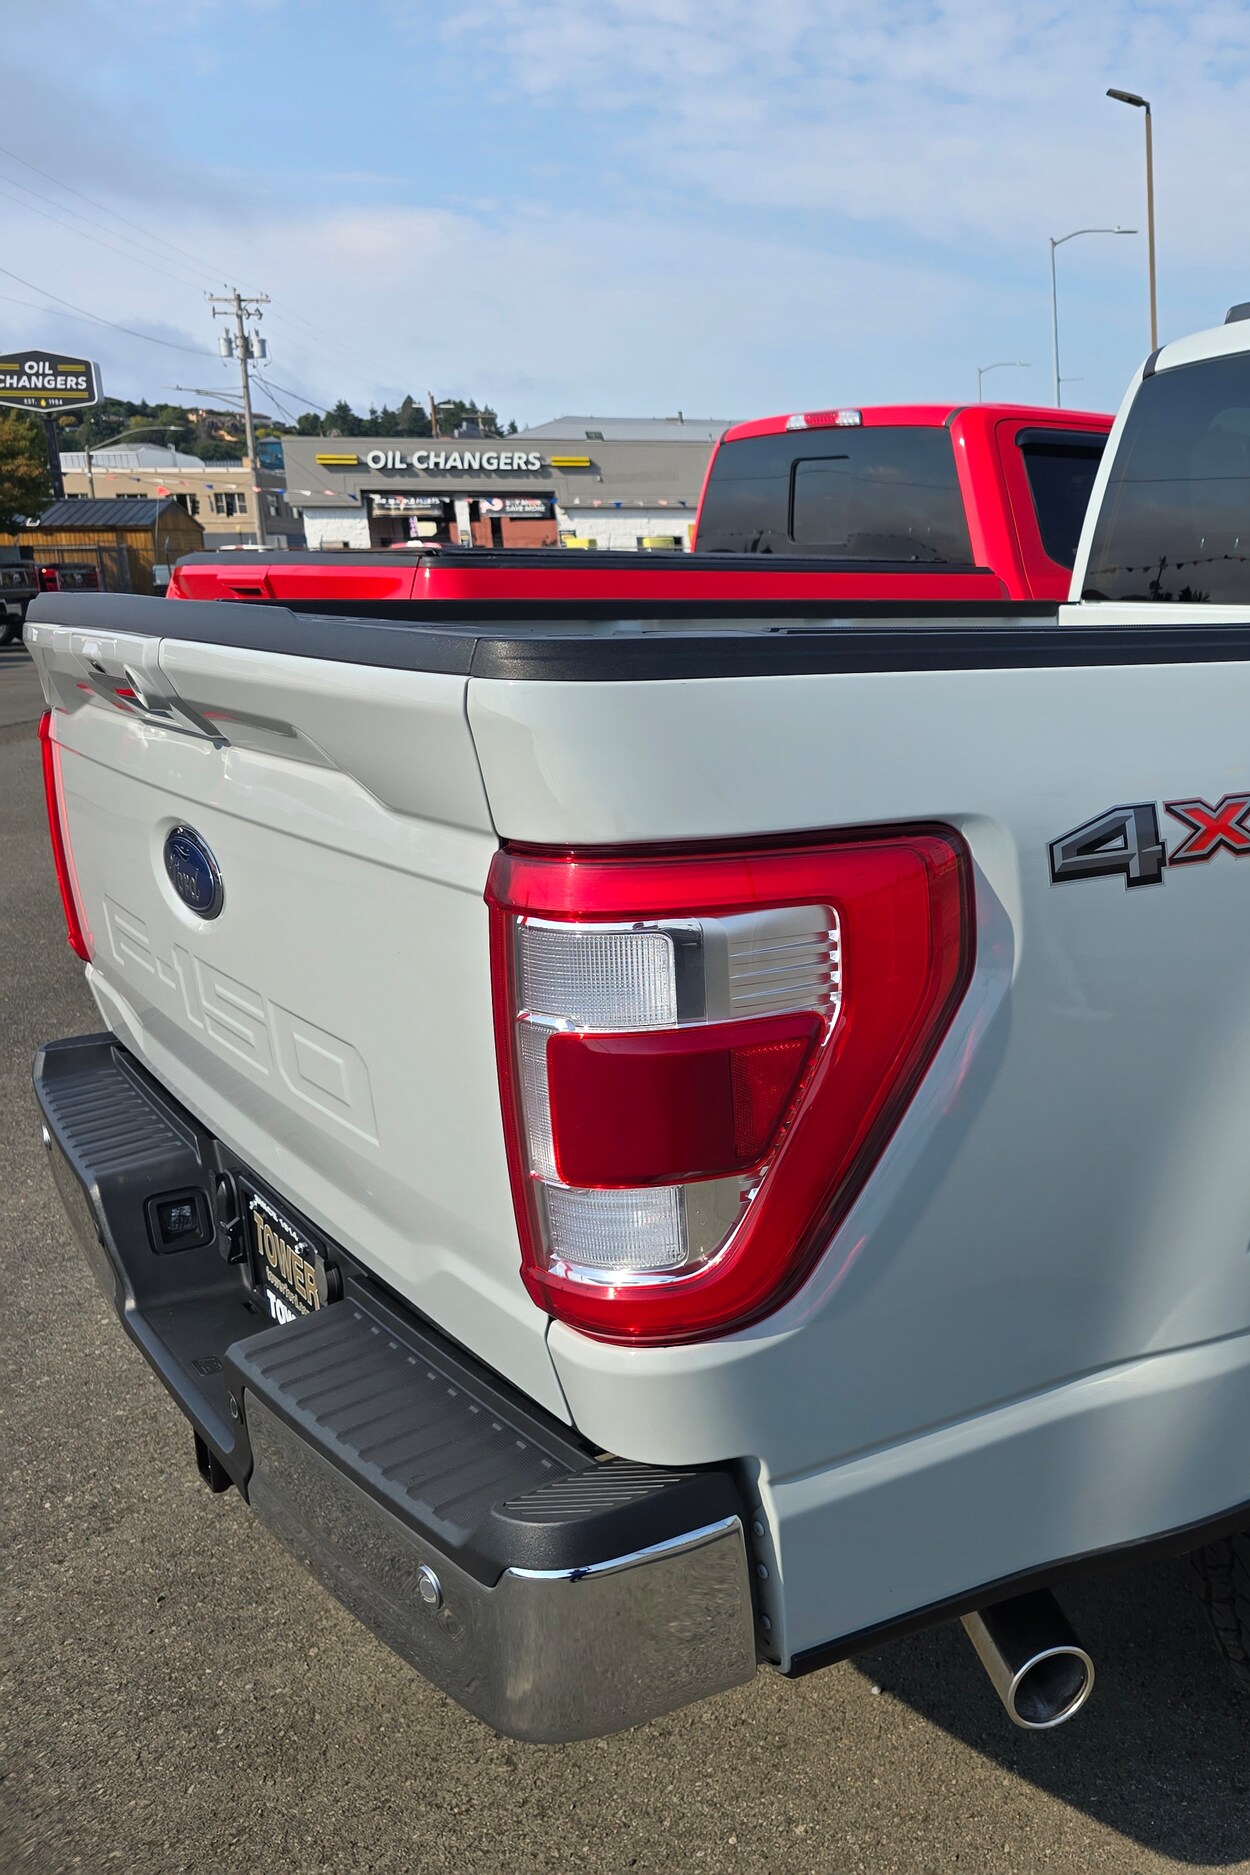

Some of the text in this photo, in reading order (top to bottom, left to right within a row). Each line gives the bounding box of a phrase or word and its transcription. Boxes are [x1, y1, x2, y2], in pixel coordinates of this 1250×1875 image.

[24, 361, 53, 374] OIL
[367, 450, 541, 471] OIL CHANGERS
[167, 845, 201, 903] Ford
[253, 1209, 320, 1312] TOWER
